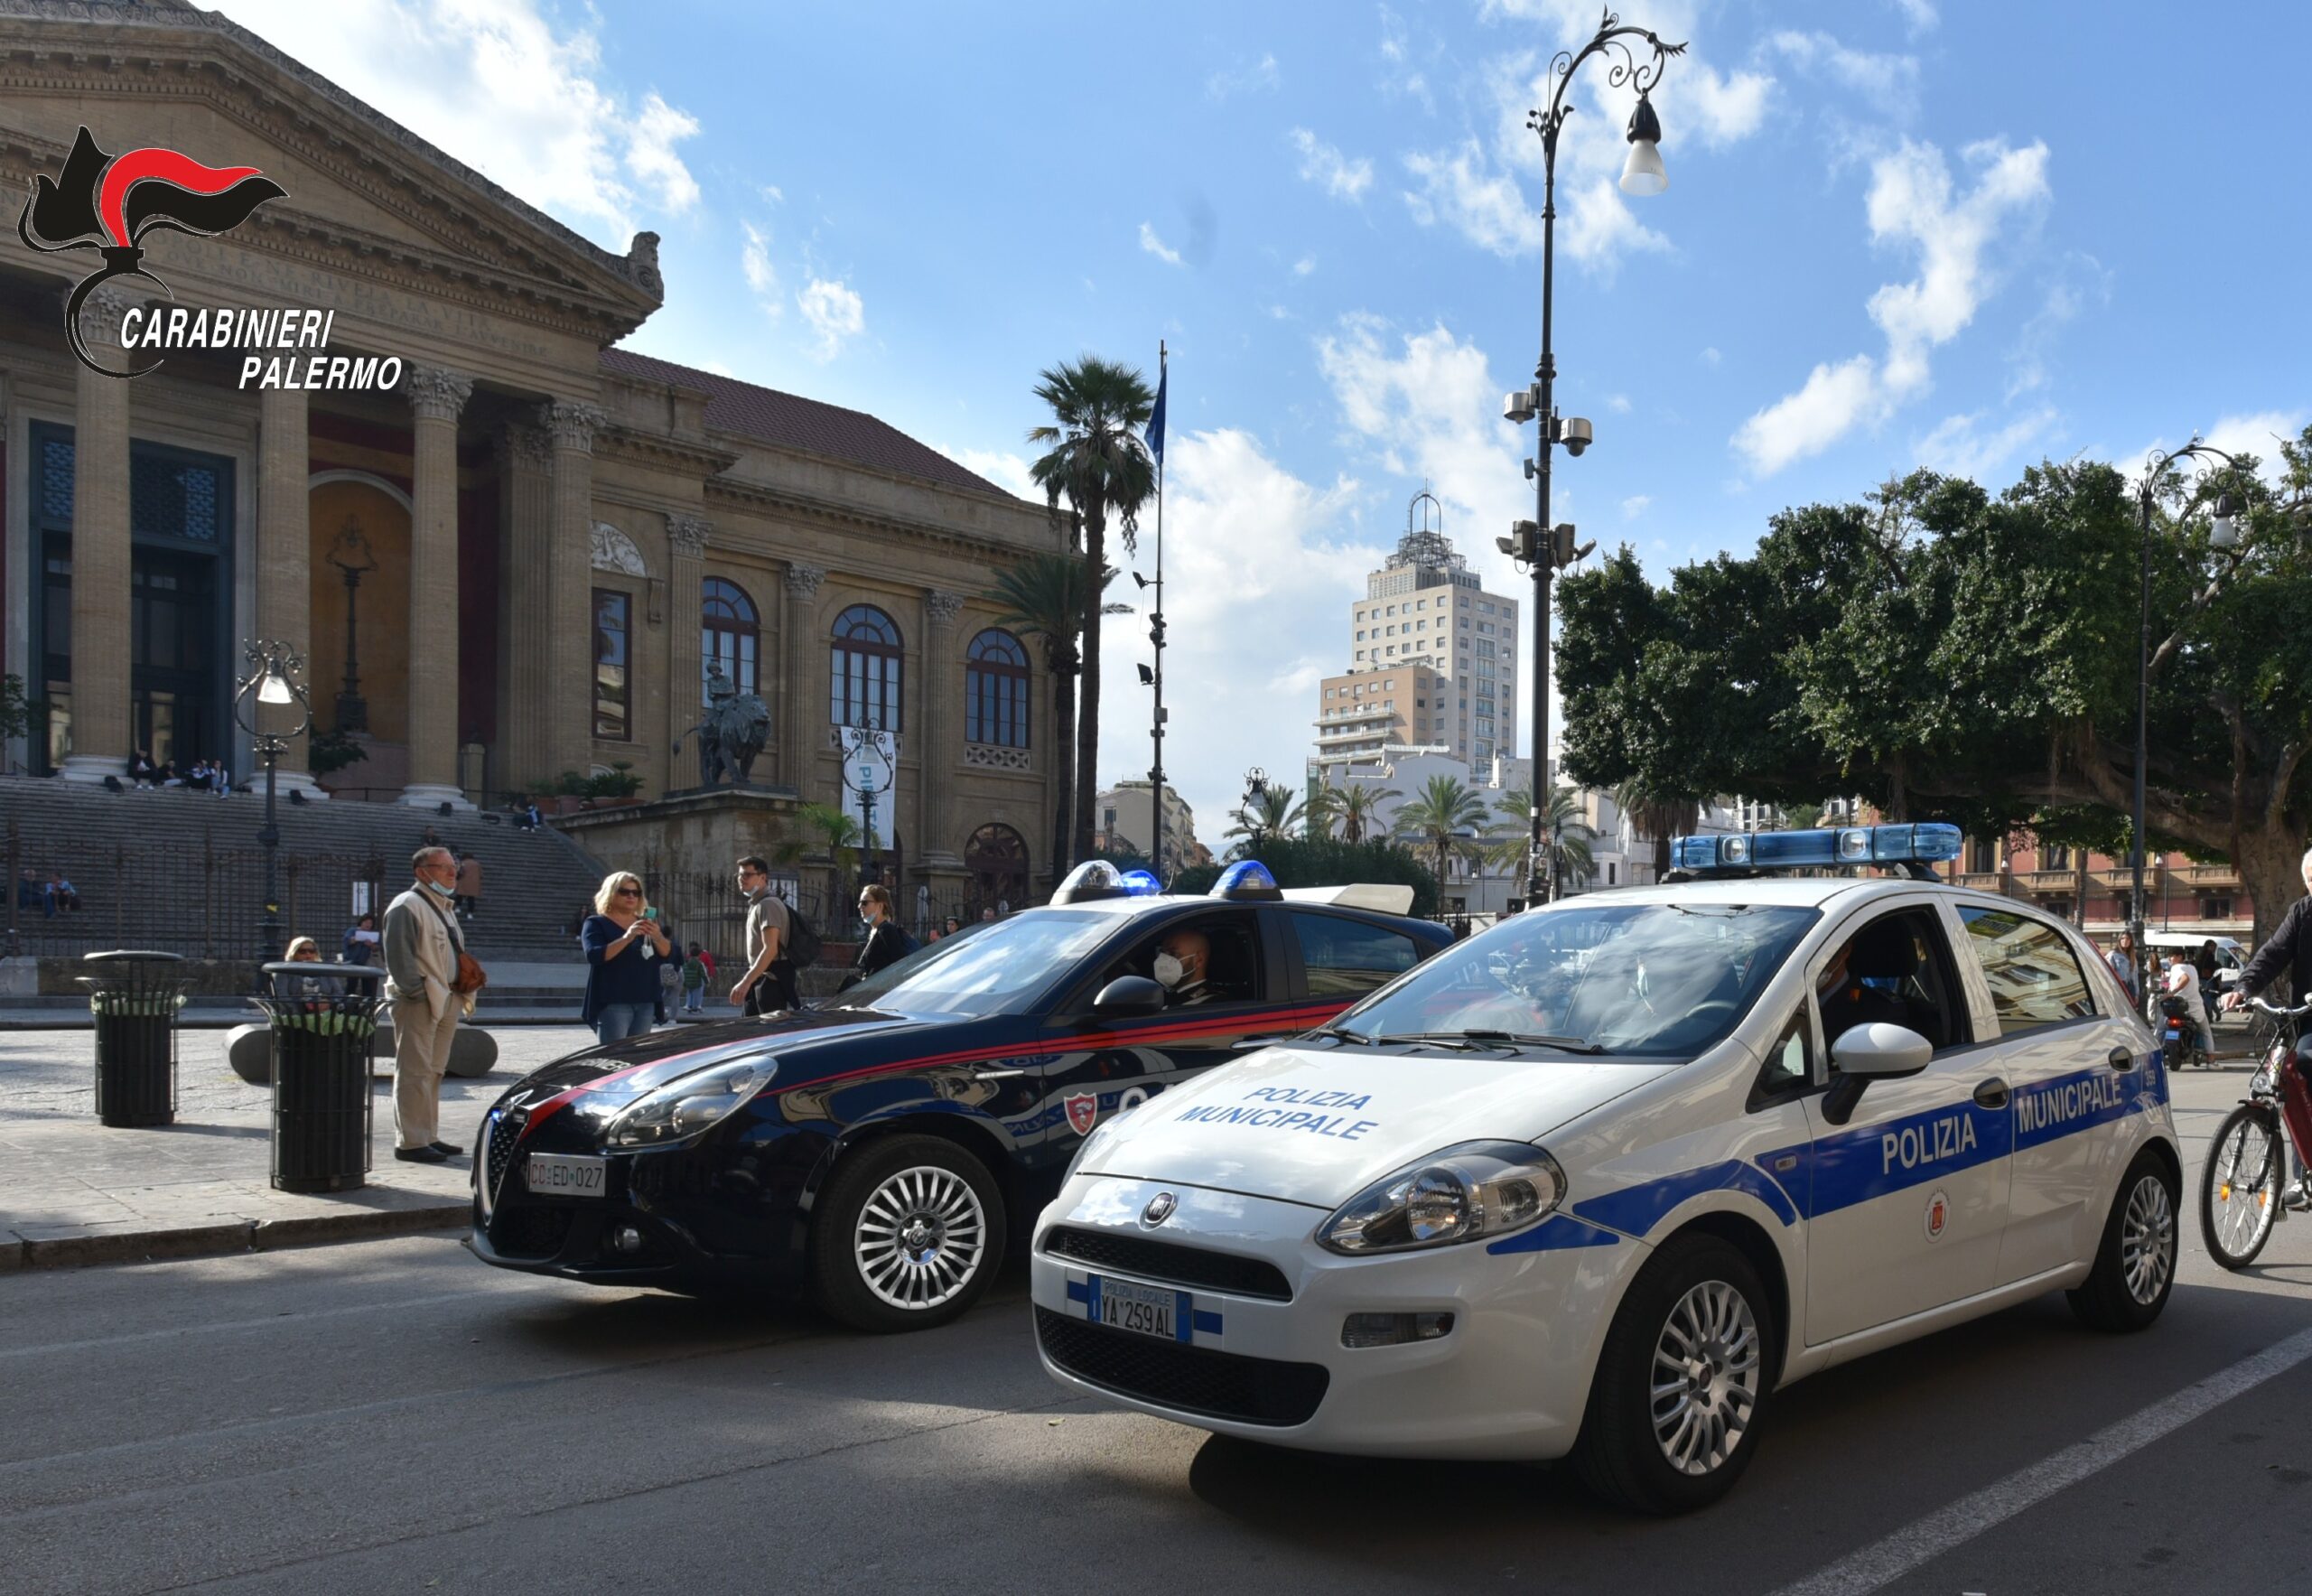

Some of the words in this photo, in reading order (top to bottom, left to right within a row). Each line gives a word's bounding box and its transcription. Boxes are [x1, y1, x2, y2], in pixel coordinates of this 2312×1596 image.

[1244, 1086, 1372, 1110] POLIZIA
[1175, 1106, 1379, 1141] MUNICIPALE
[1881, 1113, 1978, 1175] POLIZIA
[2018, 1074, 2123, 1134] MUNICIPALE
[531, 1162, 546, 1184] CC
[553, 1164, 569, 1187] ED
[575, 1166, 603, 1189] 027
[1105, 1281, 1133, 1300] POLIZIA
[1138, 1288, 1171, 1306] LOCALE
